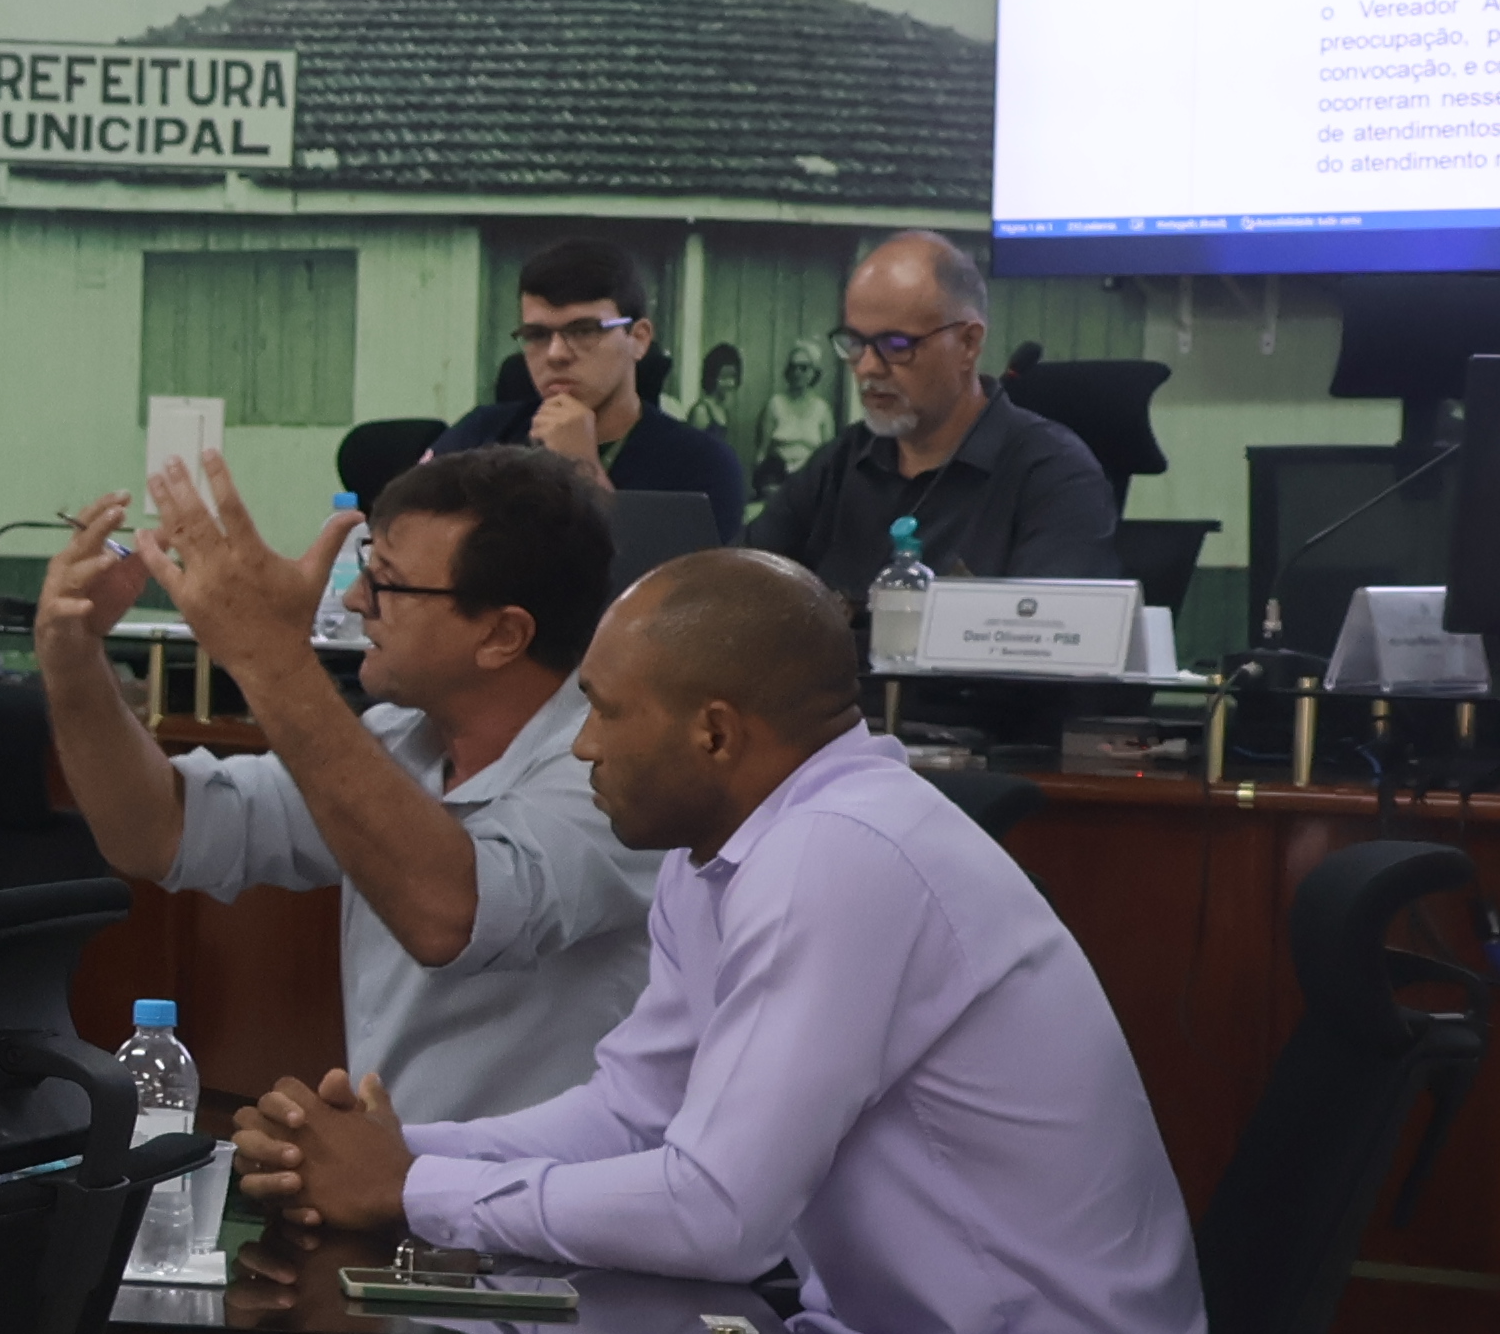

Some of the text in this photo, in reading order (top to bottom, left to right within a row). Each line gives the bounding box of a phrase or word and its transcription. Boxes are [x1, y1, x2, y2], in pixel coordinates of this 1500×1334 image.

[1321, 5, 1334, 21] o
[1320, 28, 1469, 57] preocupação,
[1319, 58, 1457, 84] convocação,
[1318, 92, 1431, 113] ocorreram
[1317, 125, 1344, 143] de
[1316, 149, 1488, 174] do atendimento
